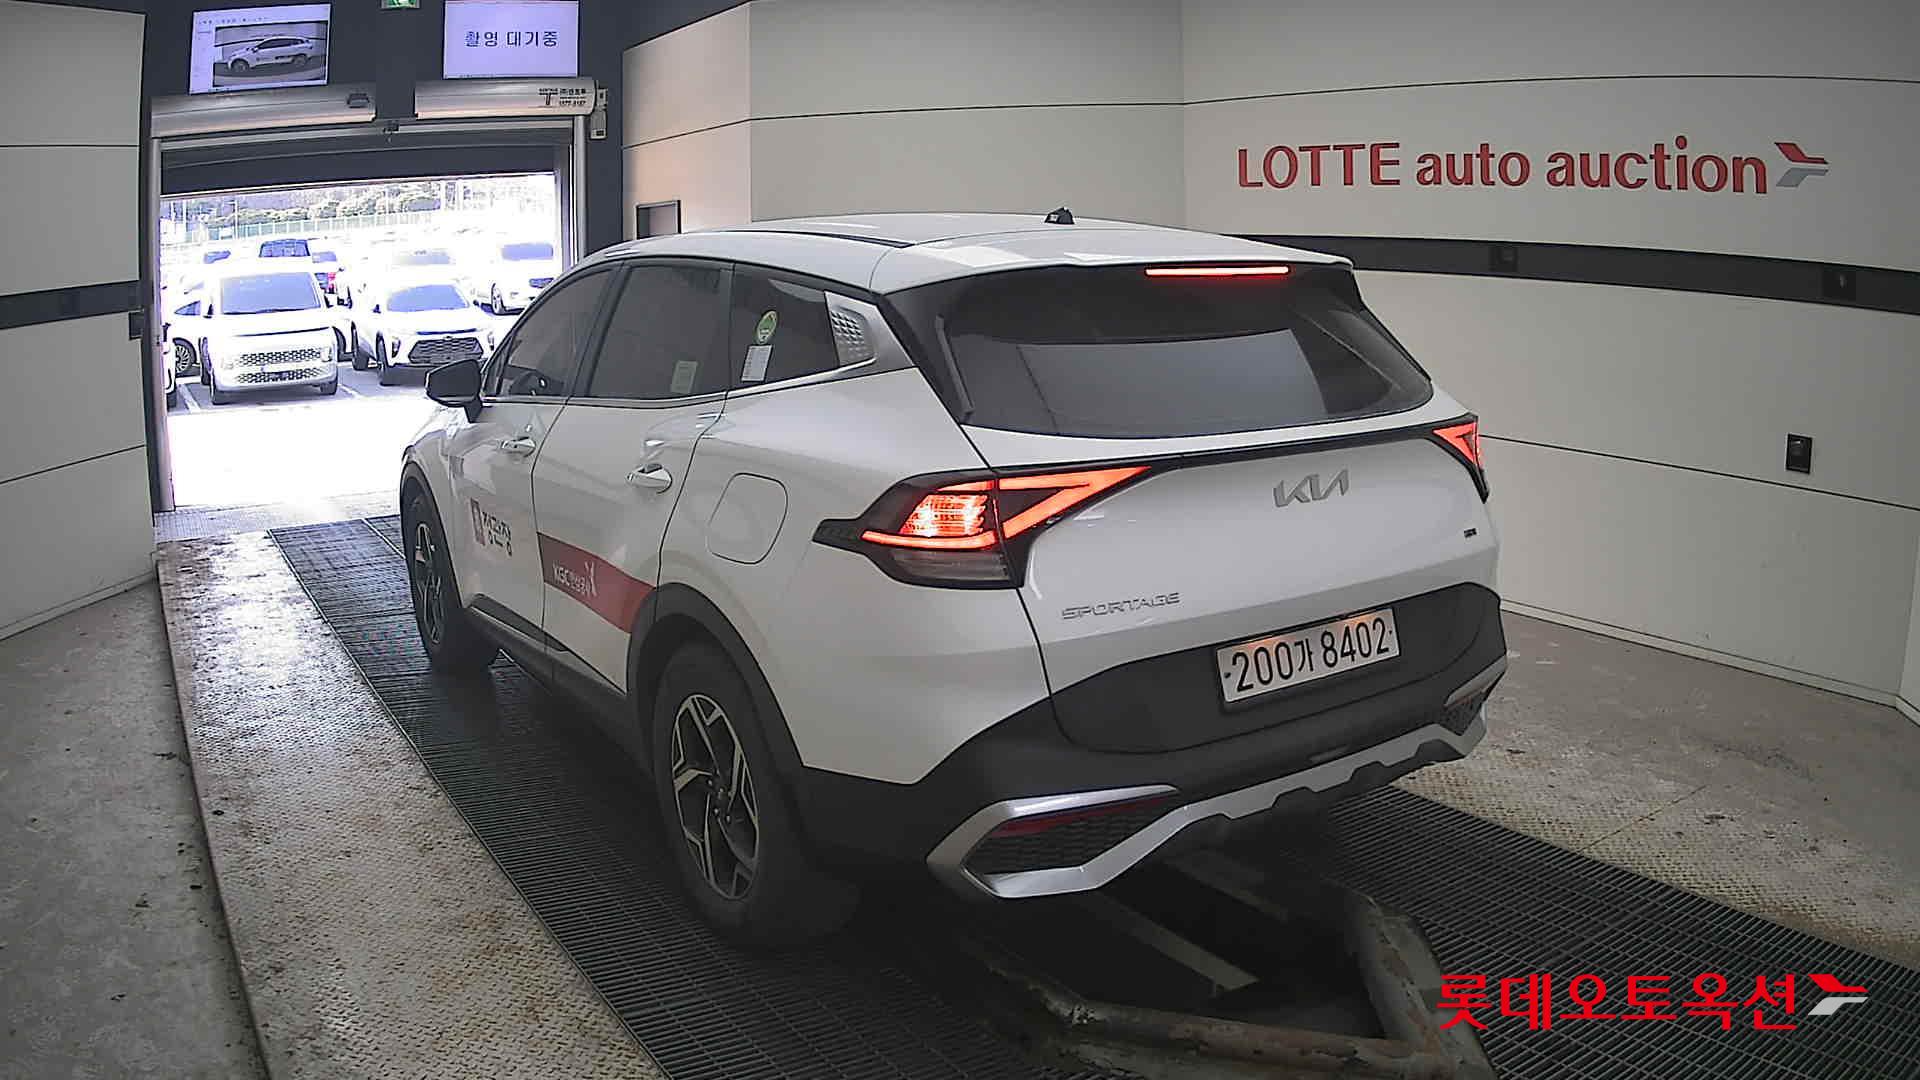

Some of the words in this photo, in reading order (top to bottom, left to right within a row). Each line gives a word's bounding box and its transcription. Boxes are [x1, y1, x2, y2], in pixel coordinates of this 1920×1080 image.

[506, 31, 558, 48] 대기중
[1237, 142, 1400, 188] LOTTE
[1416, 143, 1531, 187] auto
[1546, 135, 1767, 194] auction
[1273, 469, 1349, 507] KIA
[1062, 592, 1180, 620] SPORTAGE
[1231, 638, 1314, 693] 200가
[1320, 617, 1390, 668] 8402
